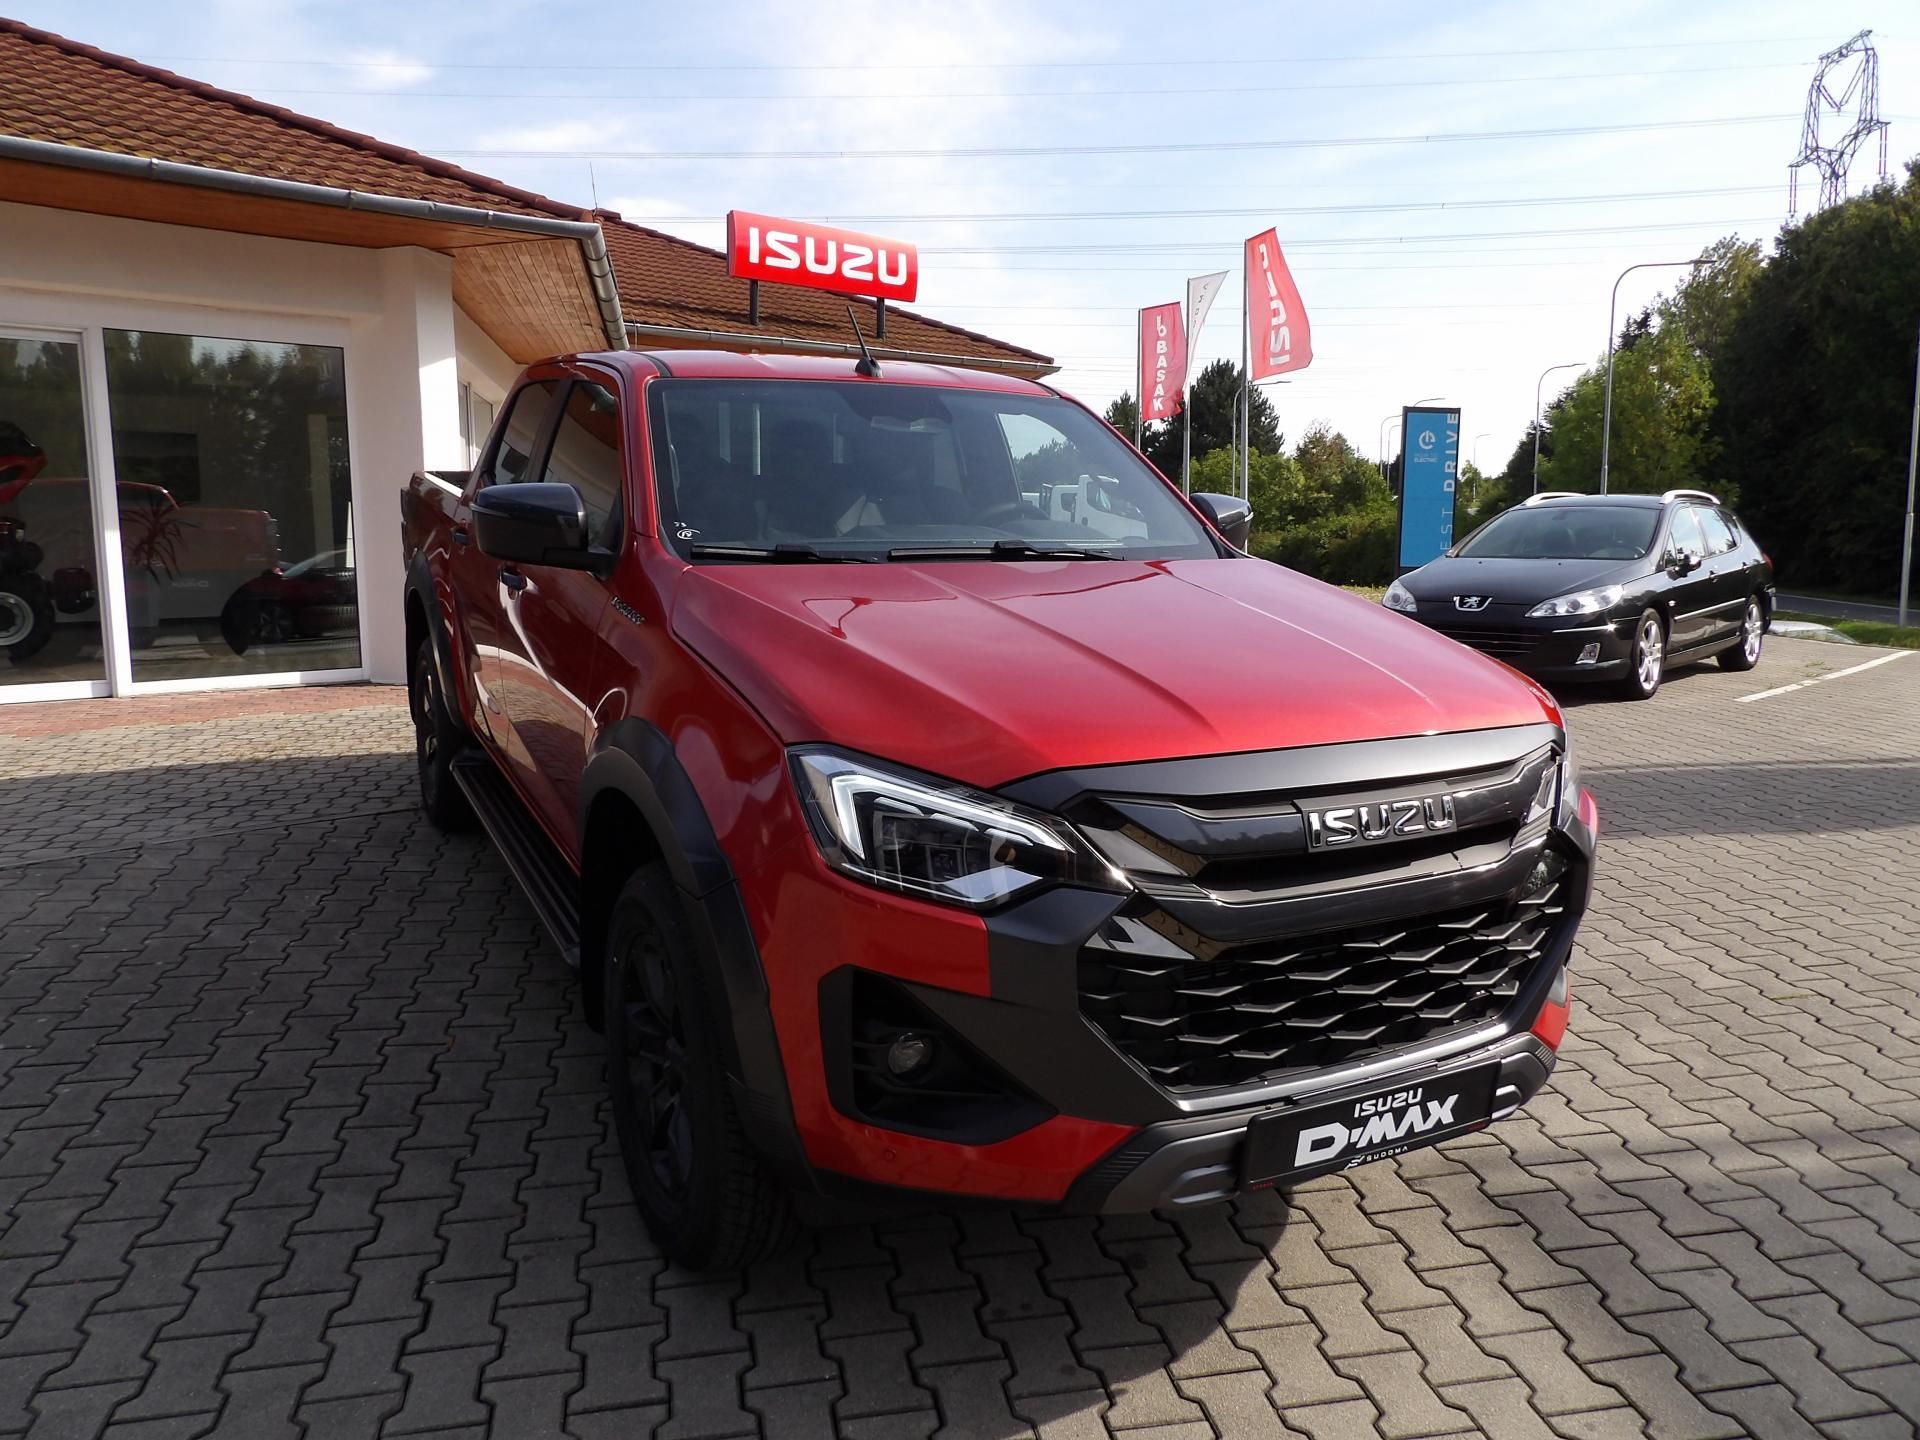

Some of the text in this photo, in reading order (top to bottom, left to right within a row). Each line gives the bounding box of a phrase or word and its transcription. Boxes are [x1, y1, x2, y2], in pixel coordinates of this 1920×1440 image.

[749, 227, 908, 286] ISUZU
[1440, 413, 1459, 551] EST DRIVE
[1308, 795, 1454, 848] ISUZU
[1294, 1093, 1459, 1168] D-MAX
[1353, 1087, 1423, 1119] ISUZU
